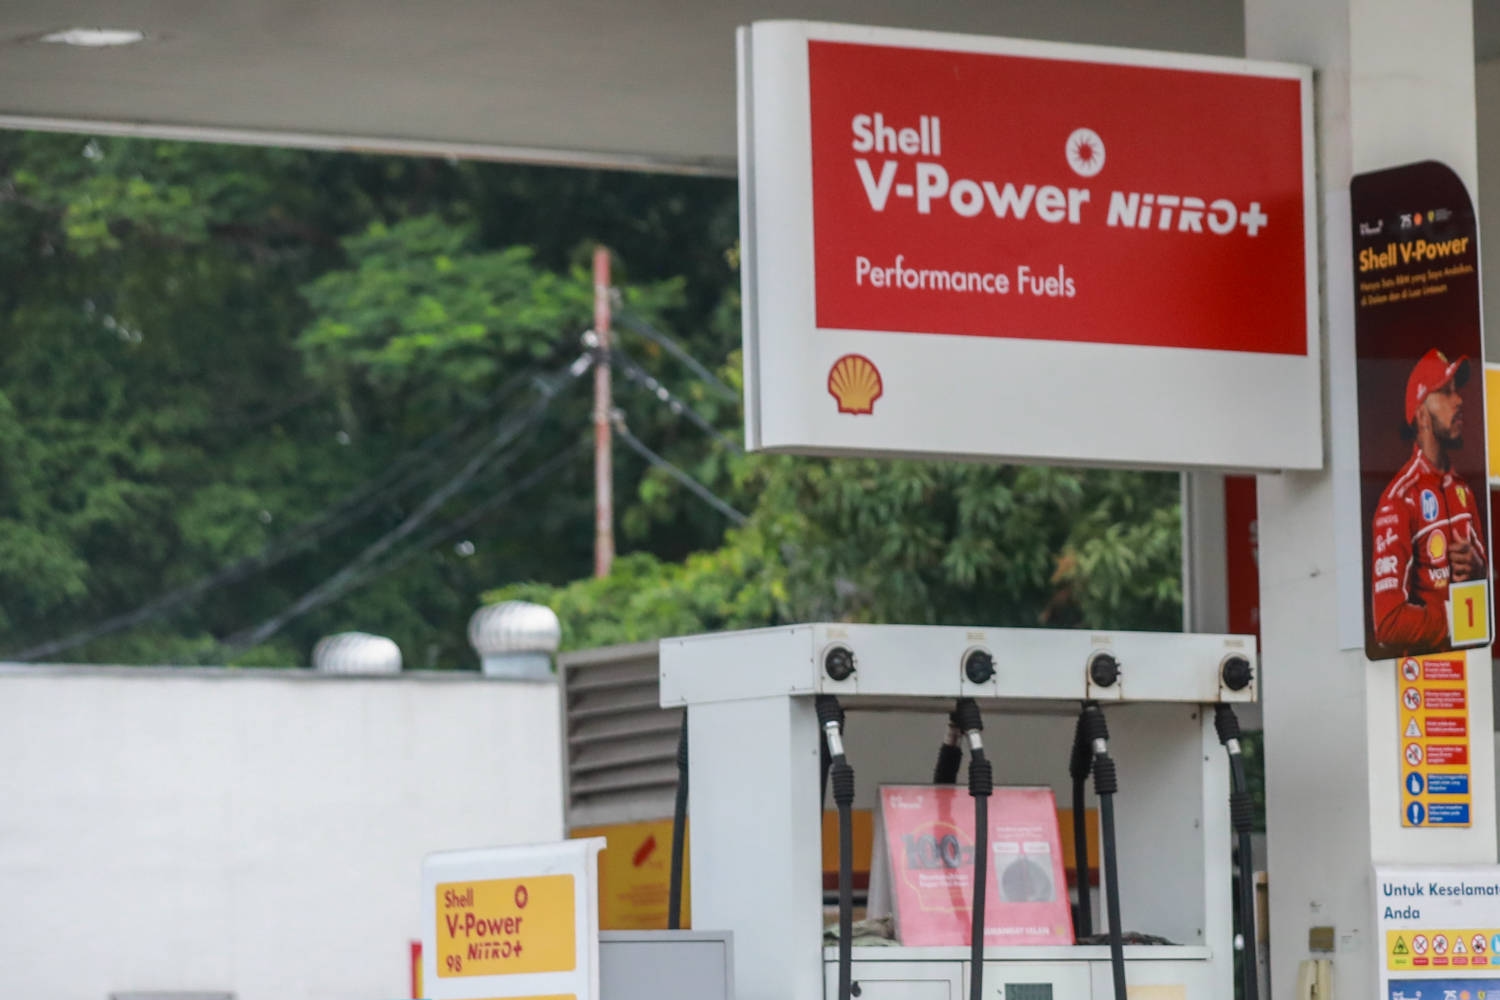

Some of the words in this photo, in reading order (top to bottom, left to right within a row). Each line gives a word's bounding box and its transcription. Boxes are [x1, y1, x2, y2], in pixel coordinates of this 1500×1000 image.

[852, 113, 941, 156] Shell
[855, 159, 1090, 224] V-Power
[1359, 242, 1397, 272] Shell
[1400, 237, 1469, 264] V-Power
[856, 255, 1009, 295] Performance
[1017, 264, 1076, 298] Fuels
[1465, 598, 1474, 628] 1
[445, 888, 474, 908] Shell
[1383, 882, 1424, 896] Untuk
[445, 913, 523, 938] V-Power
[1384, 905, 1420, 919] Anda
[446, 955, 462, 972] 98
